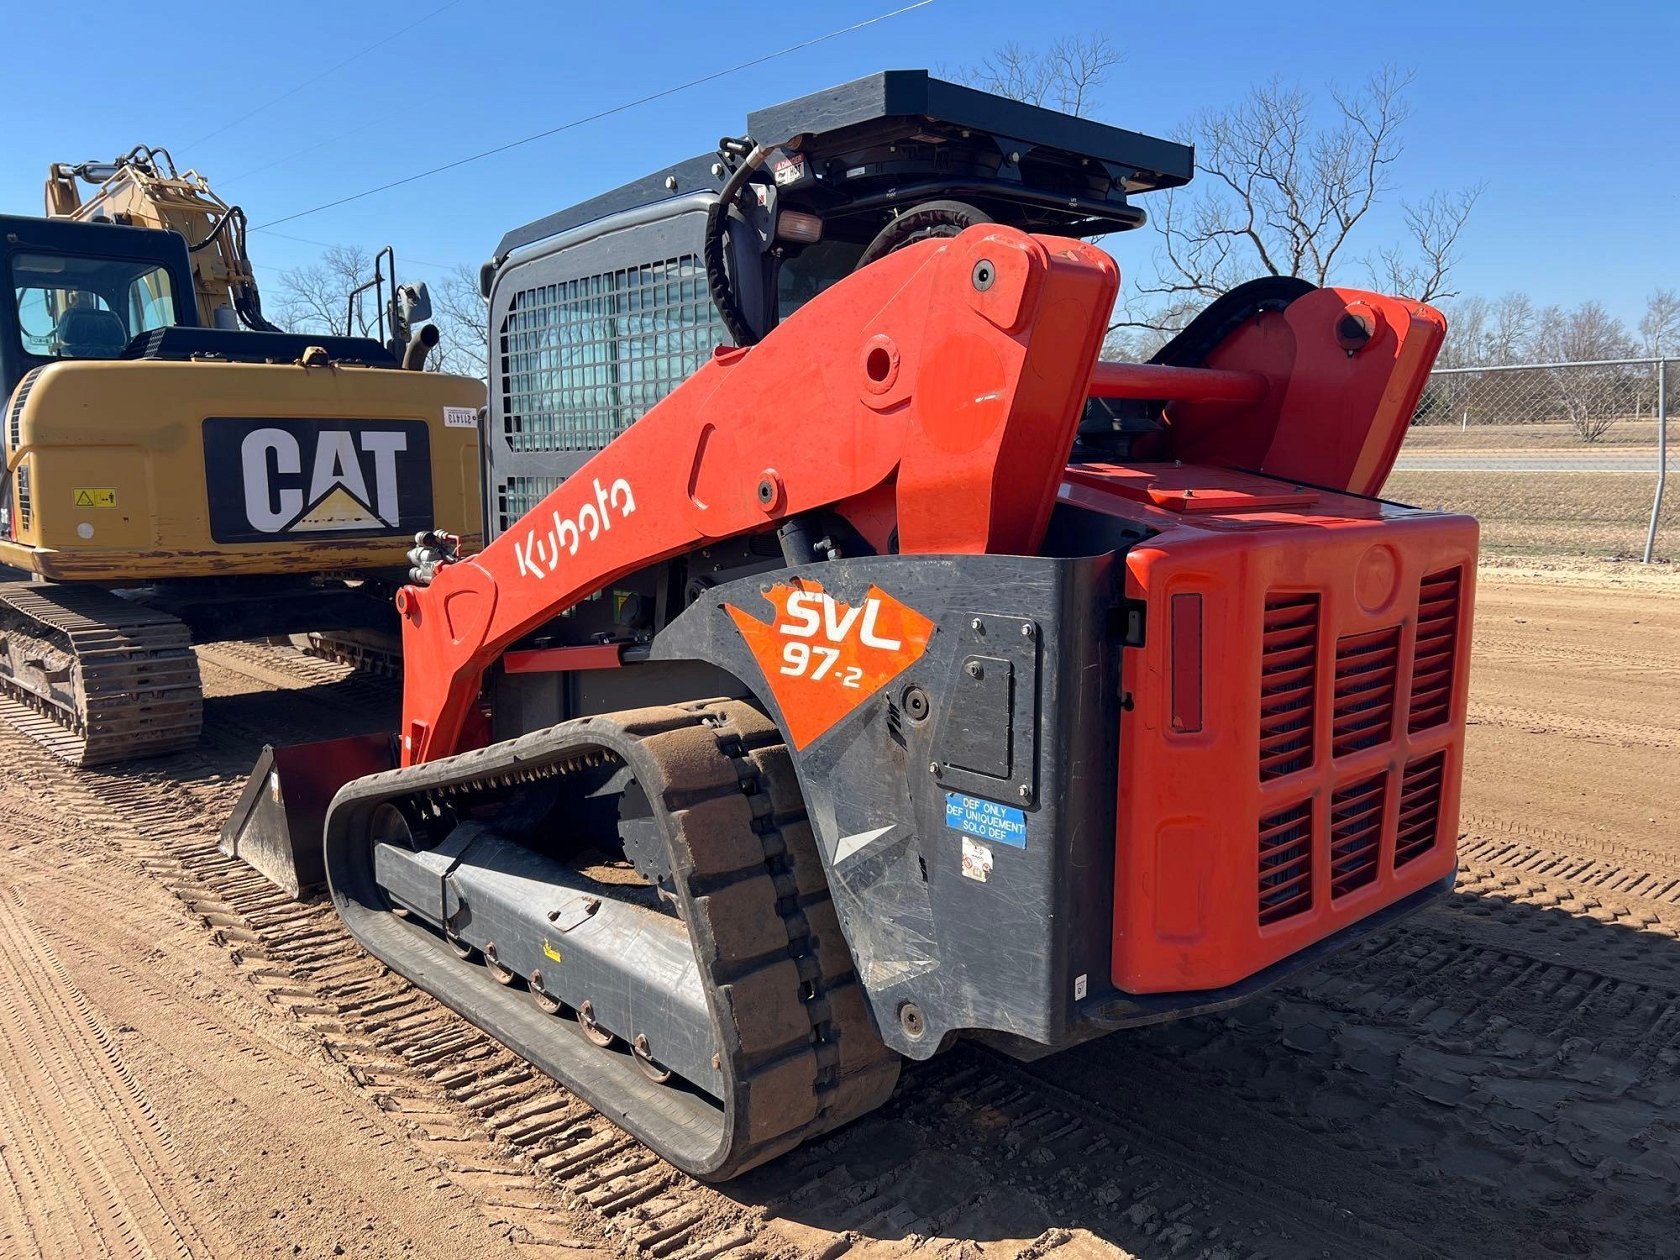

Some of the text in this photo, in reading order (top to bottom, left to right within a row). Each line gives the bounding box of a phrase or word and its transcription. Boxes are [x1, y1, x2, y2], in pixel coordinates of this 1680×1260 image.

[448, 413, 472, 424] 211413
[241, 428, 407, 533] CAT
[514, 478, 636, 580] Kubota
[779, 590, 902, 651] SVL
[779, 641, 863, 689] 97-2
[946, 803, 1025, 834] DEF UNIQUEMENT
[963, 797, 1007, 817] DEF ONLY
[963, 820, 1007, 840] SOLO DEF
